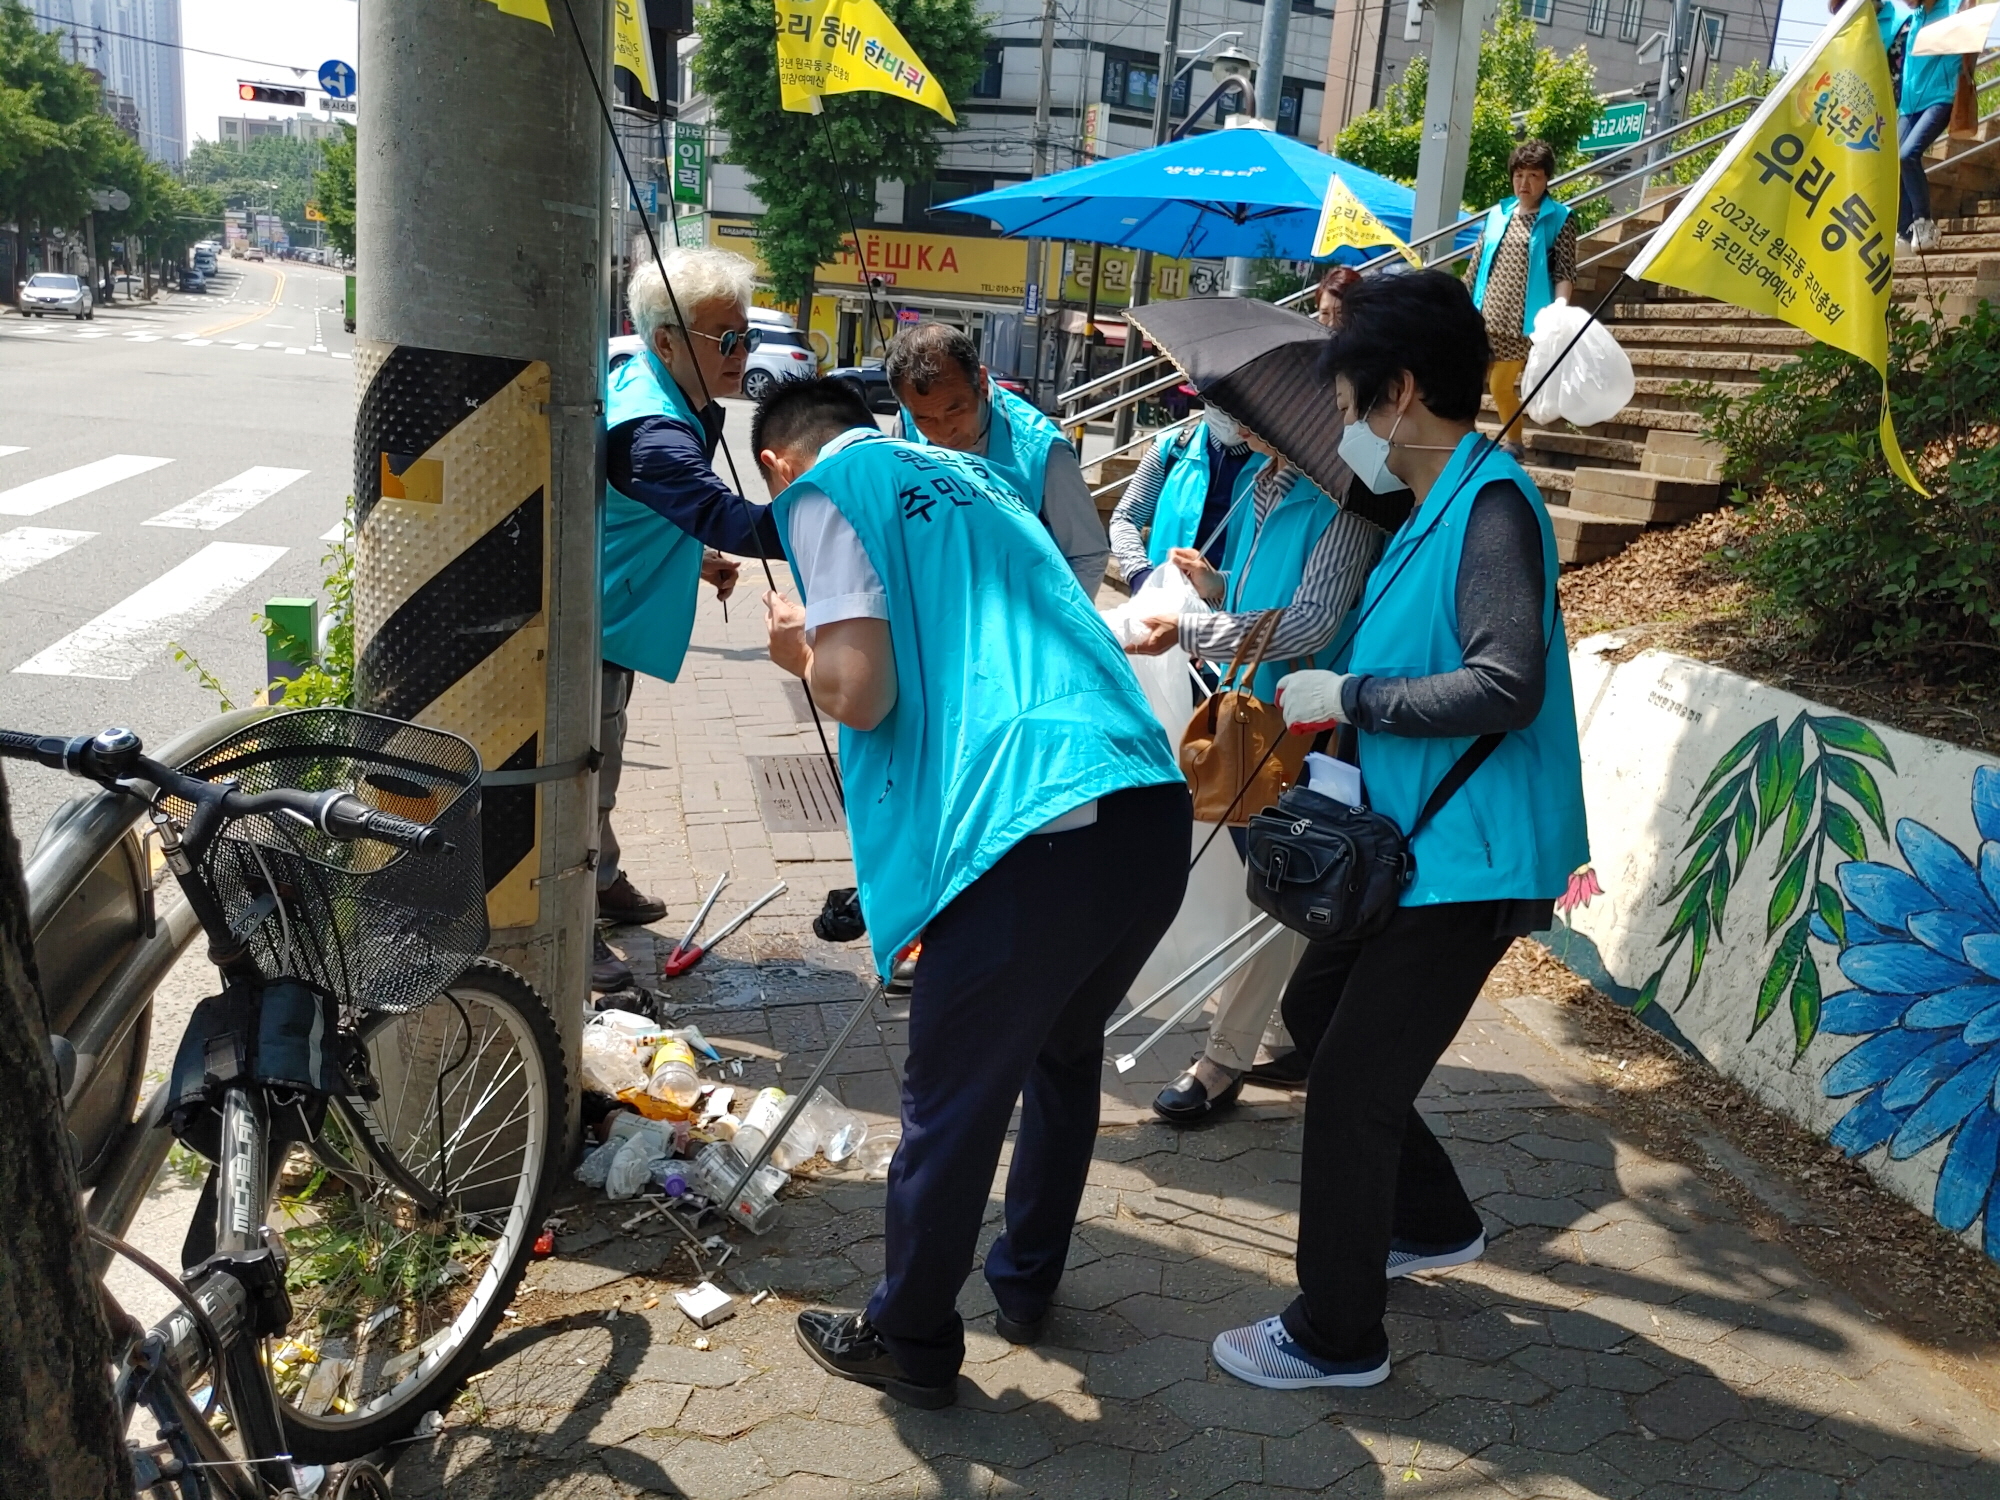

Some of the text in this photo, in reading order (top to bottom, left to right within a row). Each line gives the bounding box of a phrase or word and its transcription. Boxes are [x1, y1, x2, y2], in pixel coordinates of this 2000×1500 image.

[780, 58, 850, 82] 3년 원곡동 주민총회
[821, 16, 861, 56] 동네
[864, 39, 926, 95] 한바퀴
[781, 73, 825, 88] 민참여예산
[1582, 113, 1642, 140] 곡고교사거리
[678, 143, 701, 195] 인력
[1331, 206, 1358, 223] 우리
[1753, 133, 1892, 296] 우리 동네
[843, 235, 959, 274] ПЁШКА
[1075, 256, 1184, 297] 공원퍼
[1692, 218, 1798, 308] 및 주민참여예산
[1710, 195, 1845, 325] 2023년 원곡동 주민총회
[233, 1109, 253, 1235] MICHELAN
